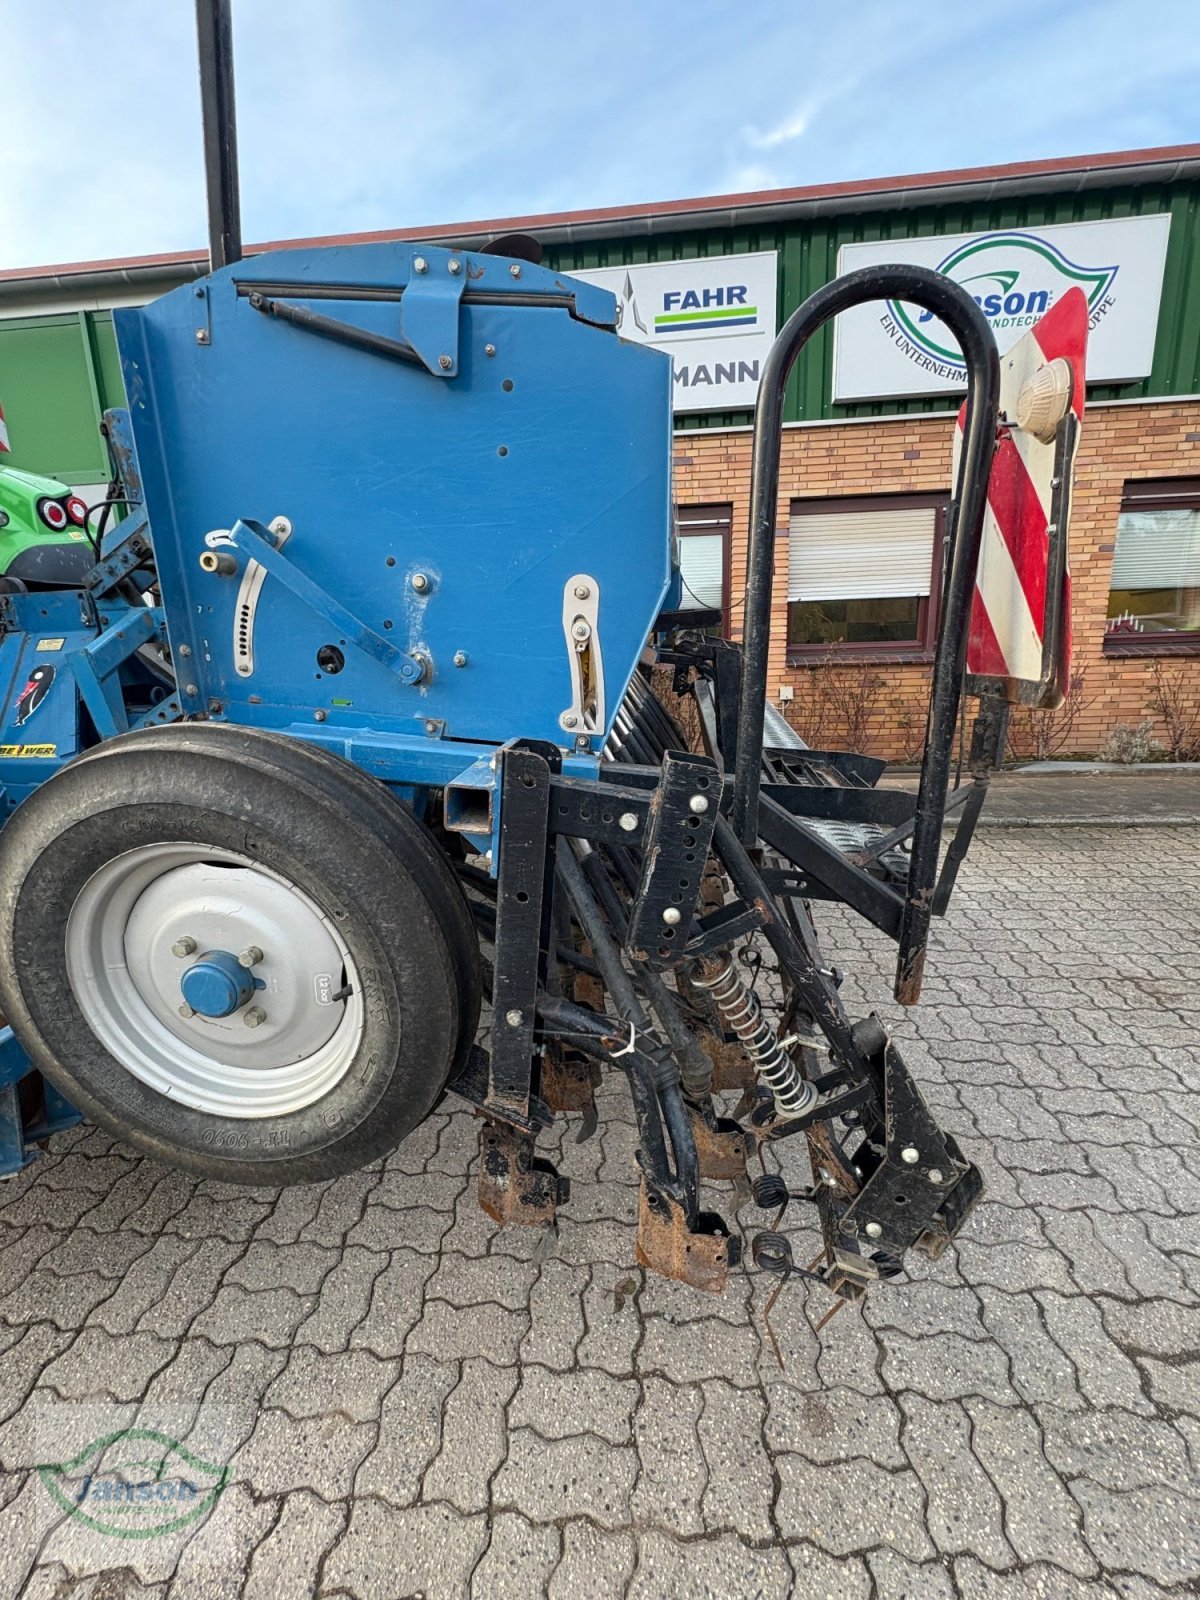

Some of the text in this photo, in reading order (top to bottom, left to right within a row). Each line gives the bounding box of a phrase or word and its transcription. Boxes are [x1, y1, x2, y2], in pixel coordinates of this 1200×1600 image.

[663, 285, 748, 311] FAHR
[880, 314, 899, 339] EIN
[895, 334, 969, 383] UNTERNEHM
[1087, 295, 1116, 331] UPPE
